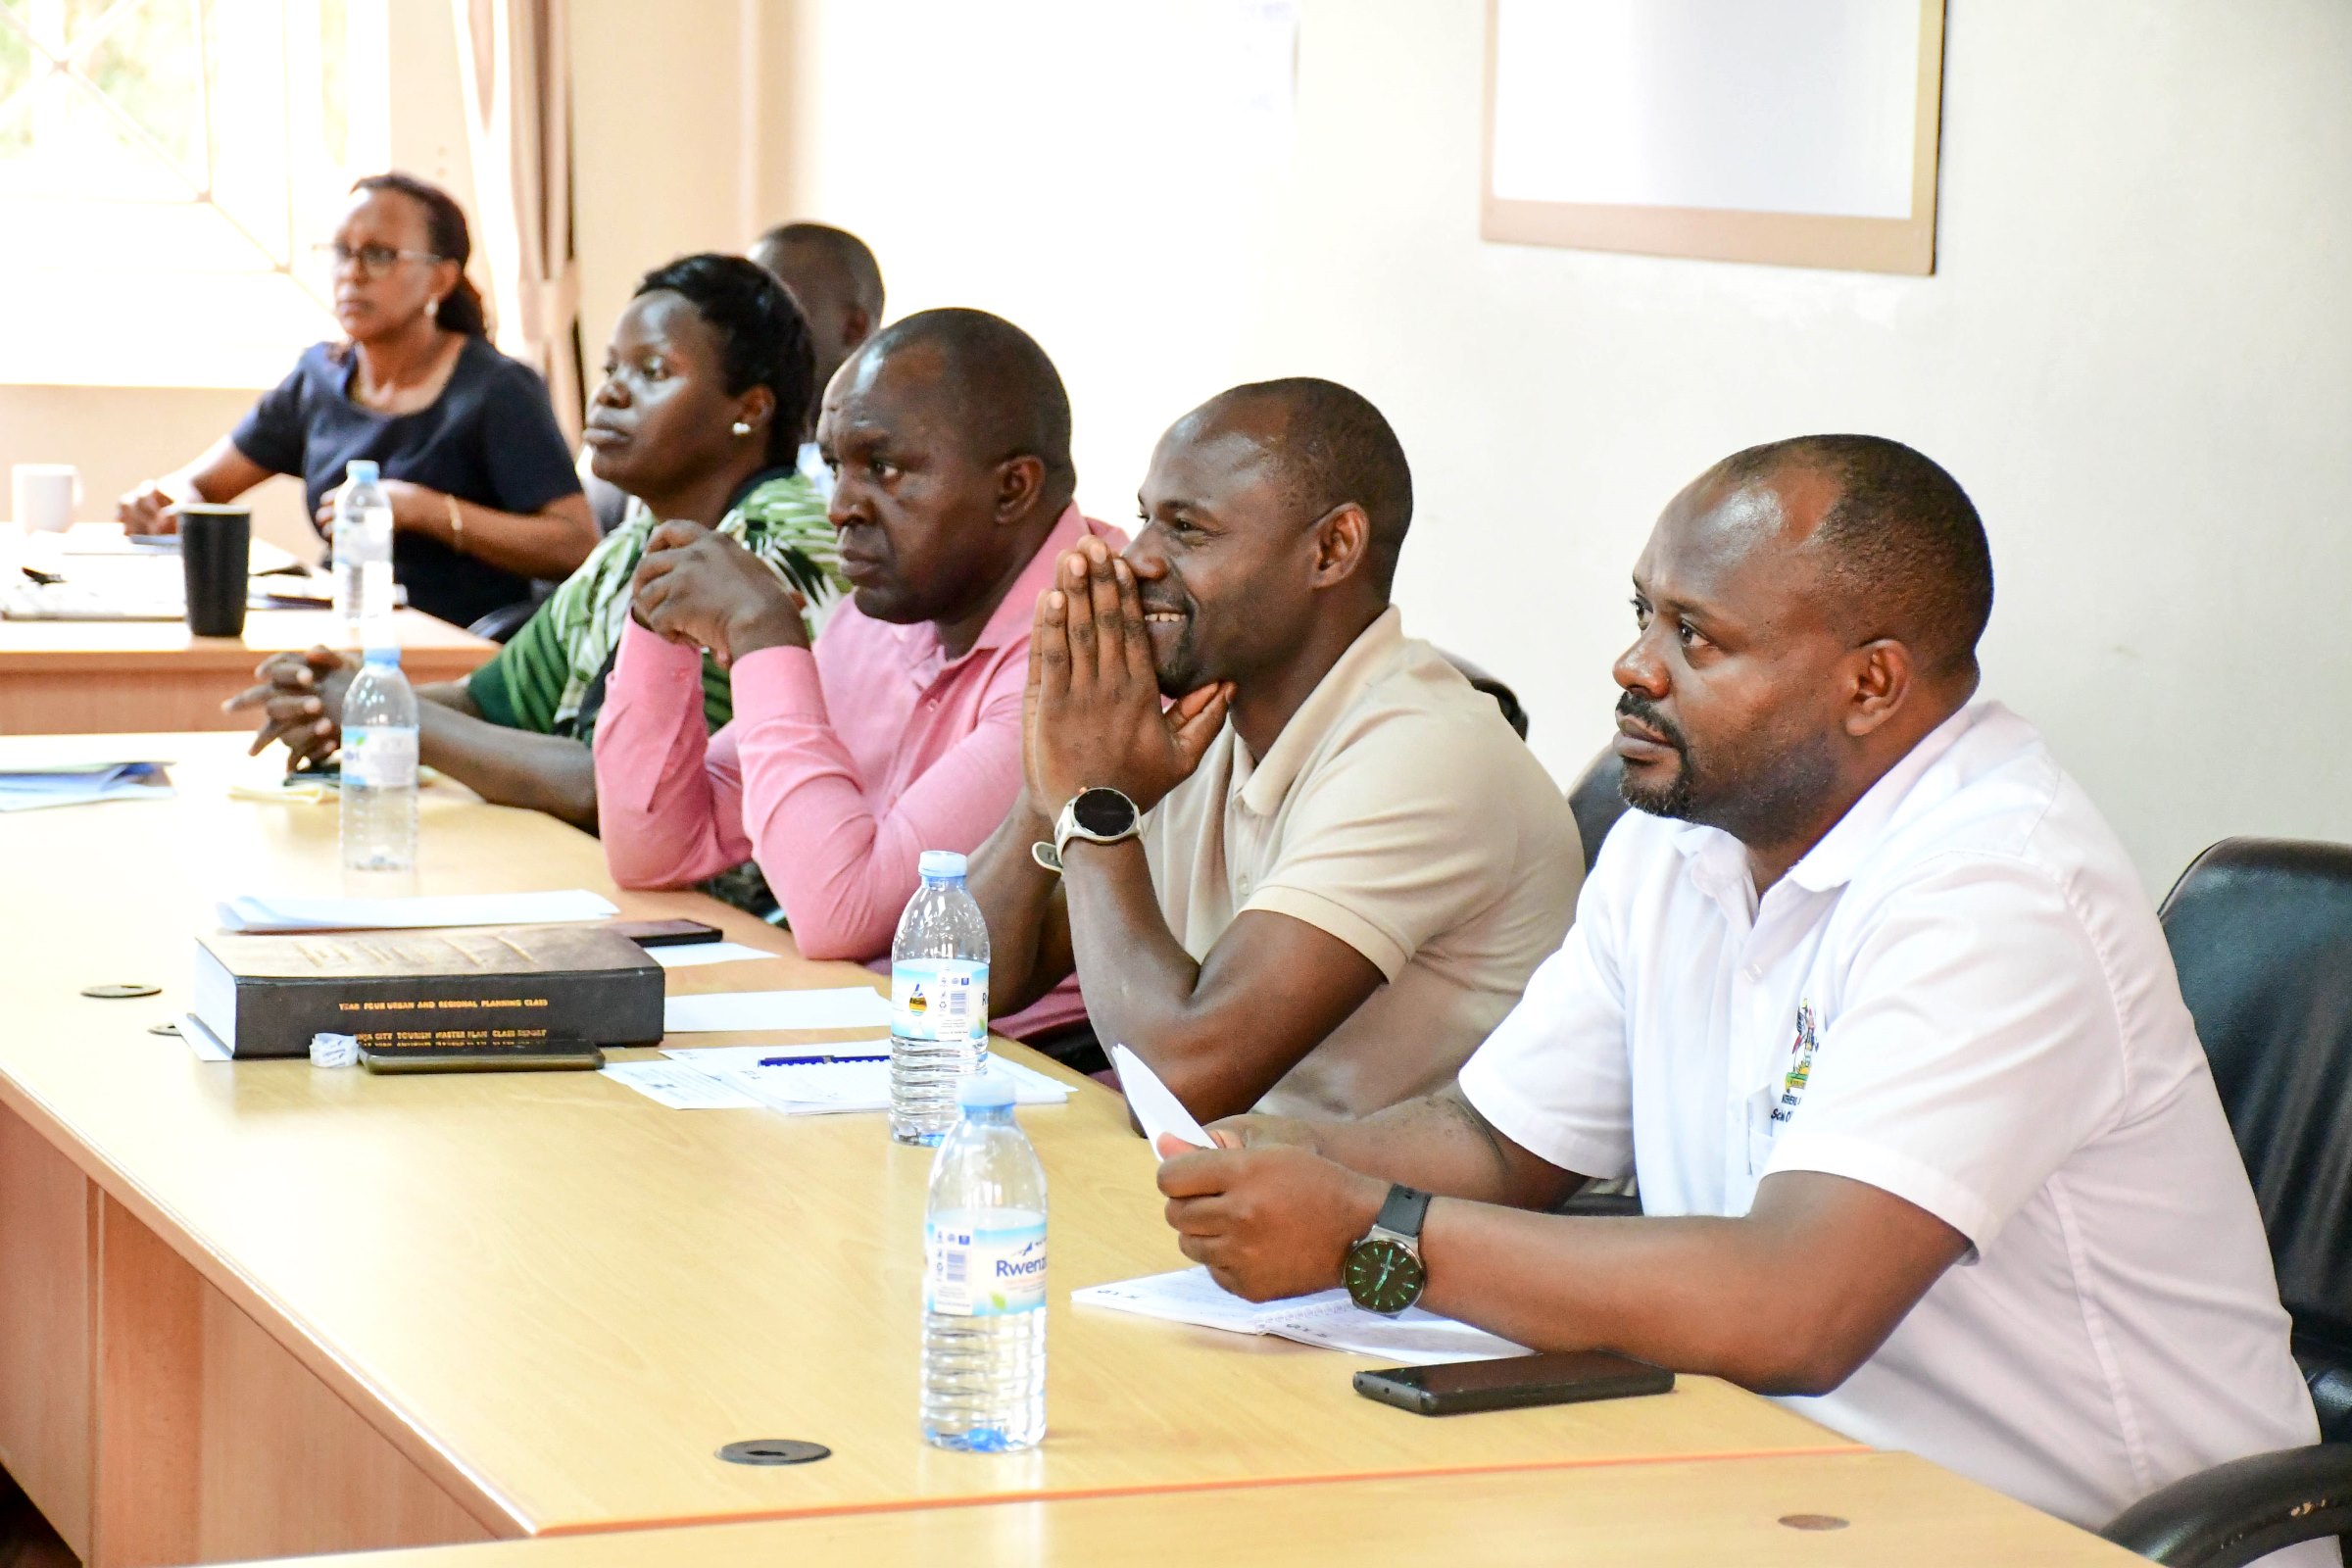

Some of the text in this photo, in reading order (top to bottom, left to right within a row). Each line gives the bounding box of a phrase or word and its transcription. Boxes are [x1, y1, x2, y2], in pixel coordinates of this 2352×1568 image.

[416, 1001, 436, 1009] AND
[438, 1000, 478, 1008] REGIONAL
[524, 999, 549, 1007] CLASS
[396, 1031, 432, 1040] TOURISM
[435, 1030, 466, 1039] MASTER
[466, 1030, 488, 1039] PLAN
[492, 1029, 515, 1038] CLASS
[996, 1256, 1047, 1278] Rwenz
